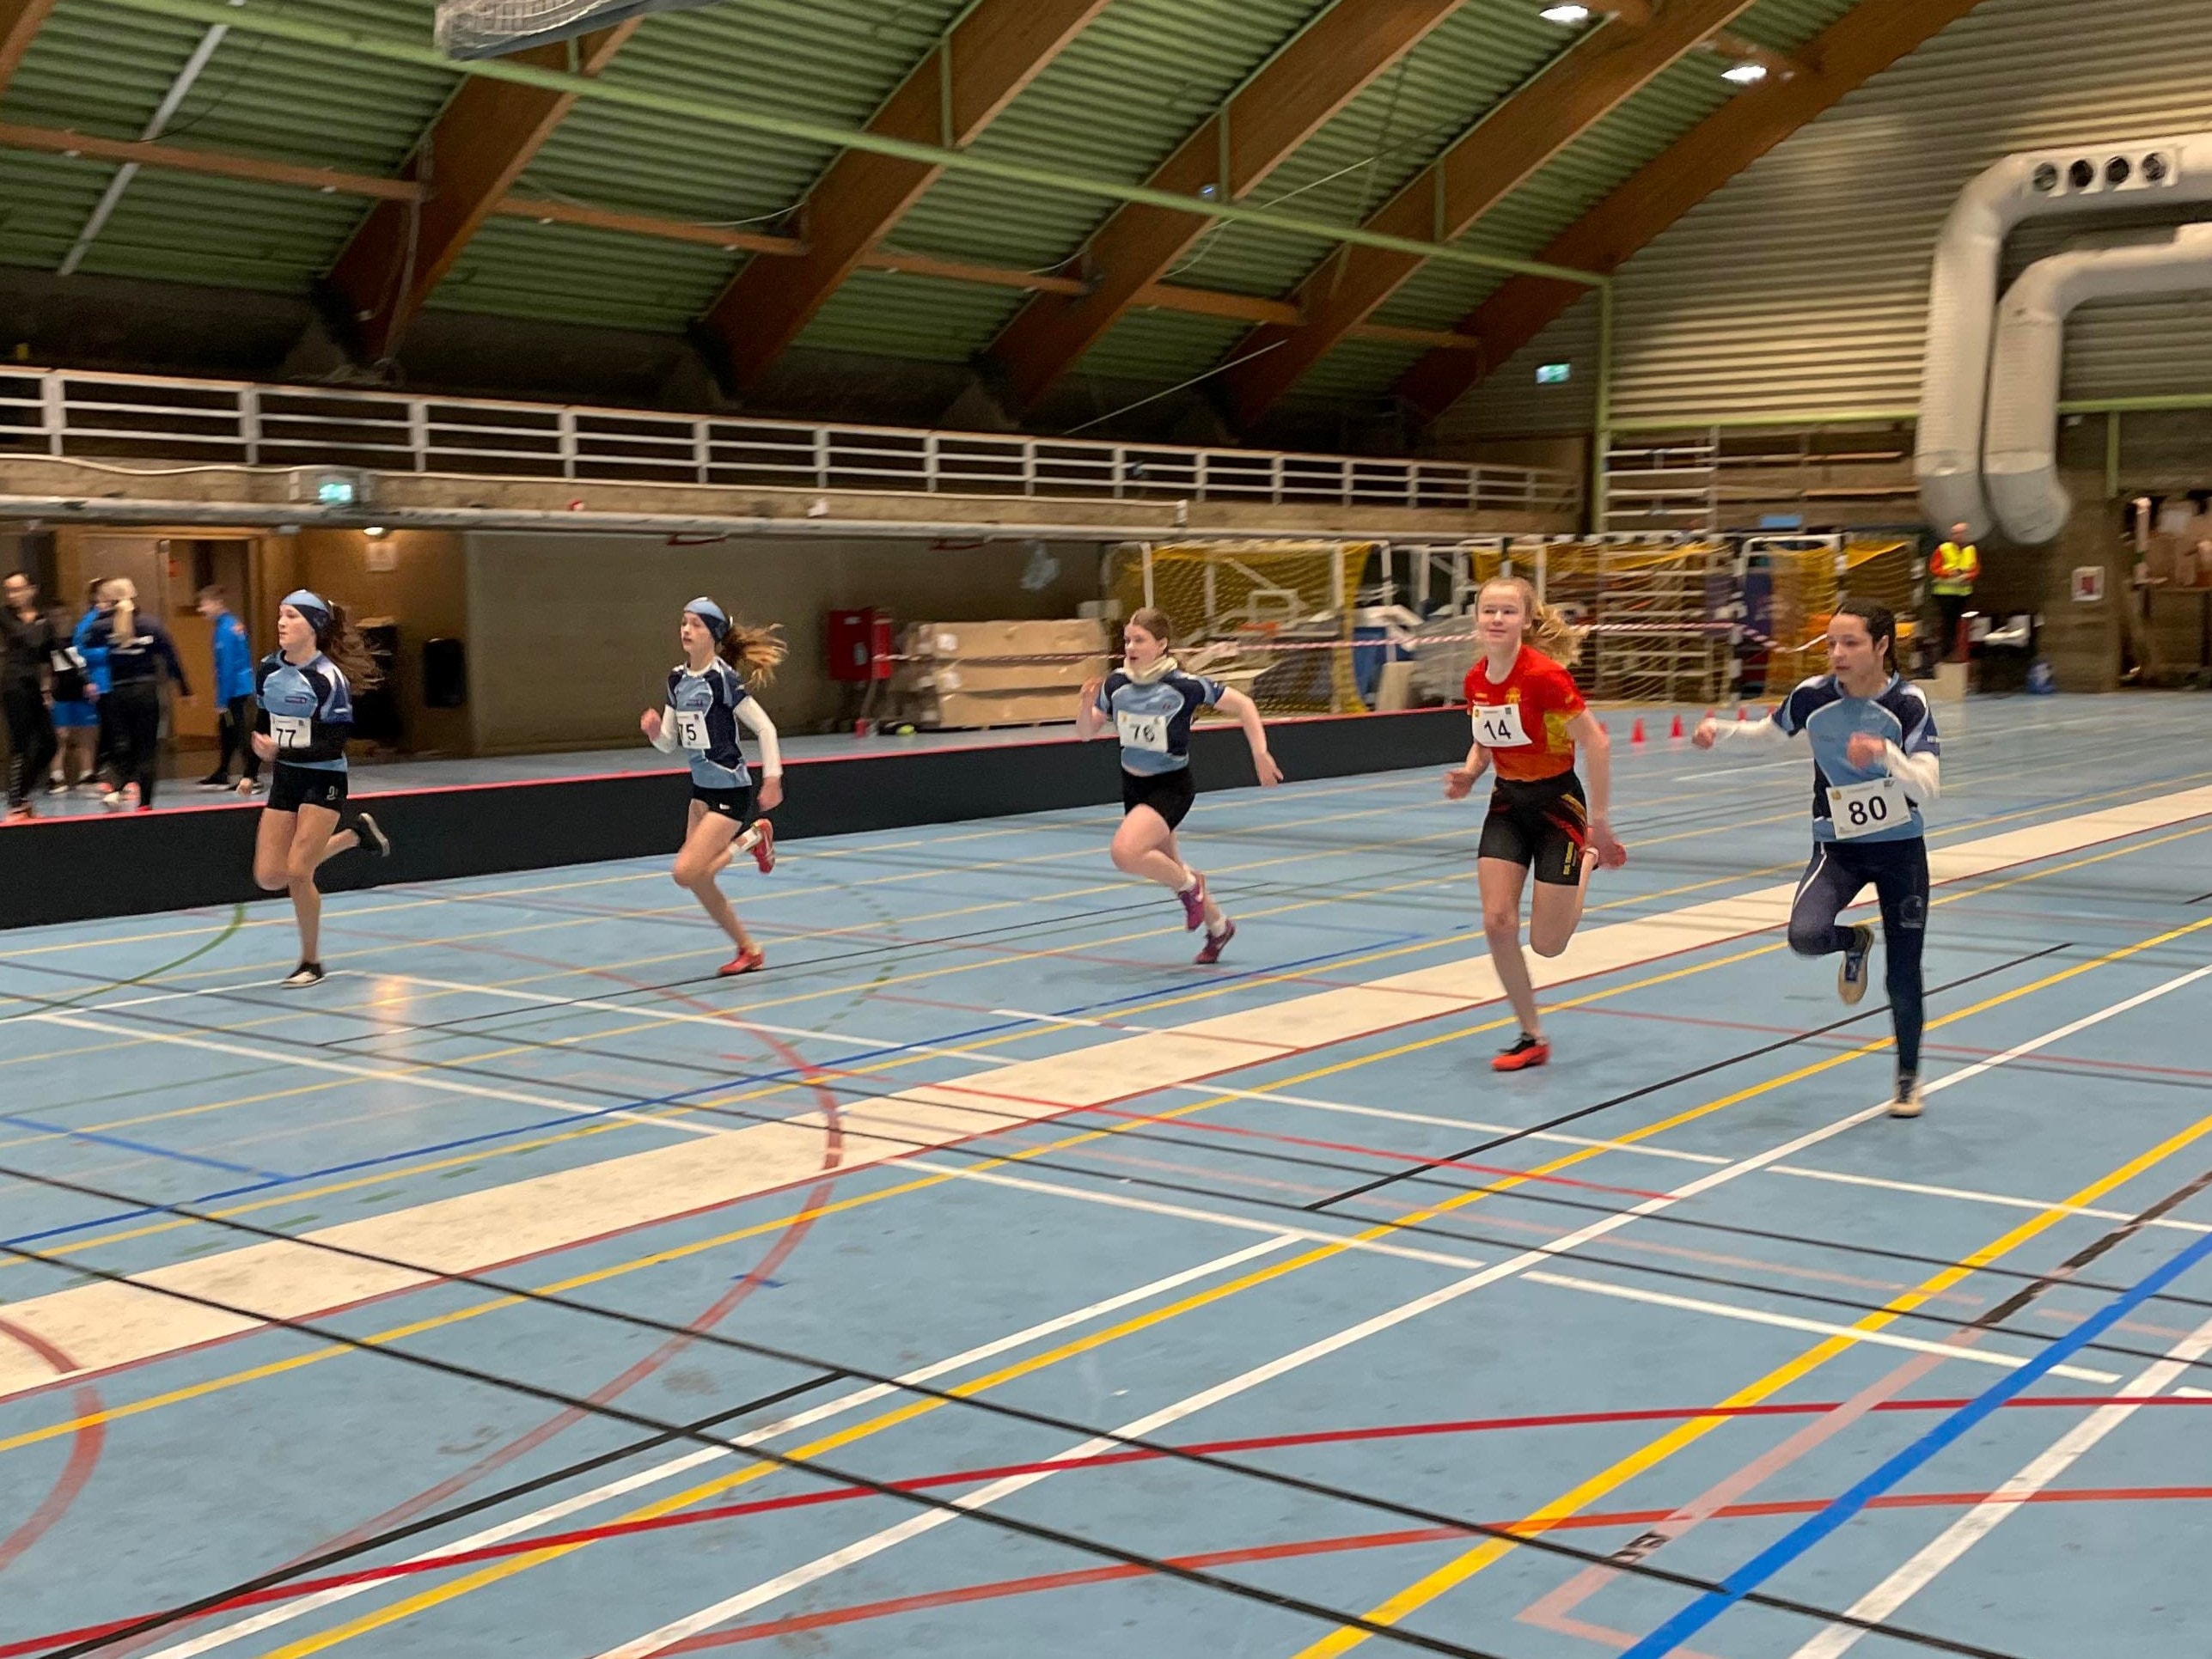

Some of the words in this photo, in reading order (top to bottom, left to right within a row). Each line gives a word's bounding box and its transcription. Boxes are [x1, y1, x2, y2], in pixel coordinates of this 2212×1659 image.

[276, 728, 296, 747] 77
[1129, 724, 1155, 742] 76
[1484, 719, 1512, 741] 14
[1848, 796, 1887, 826] 80
